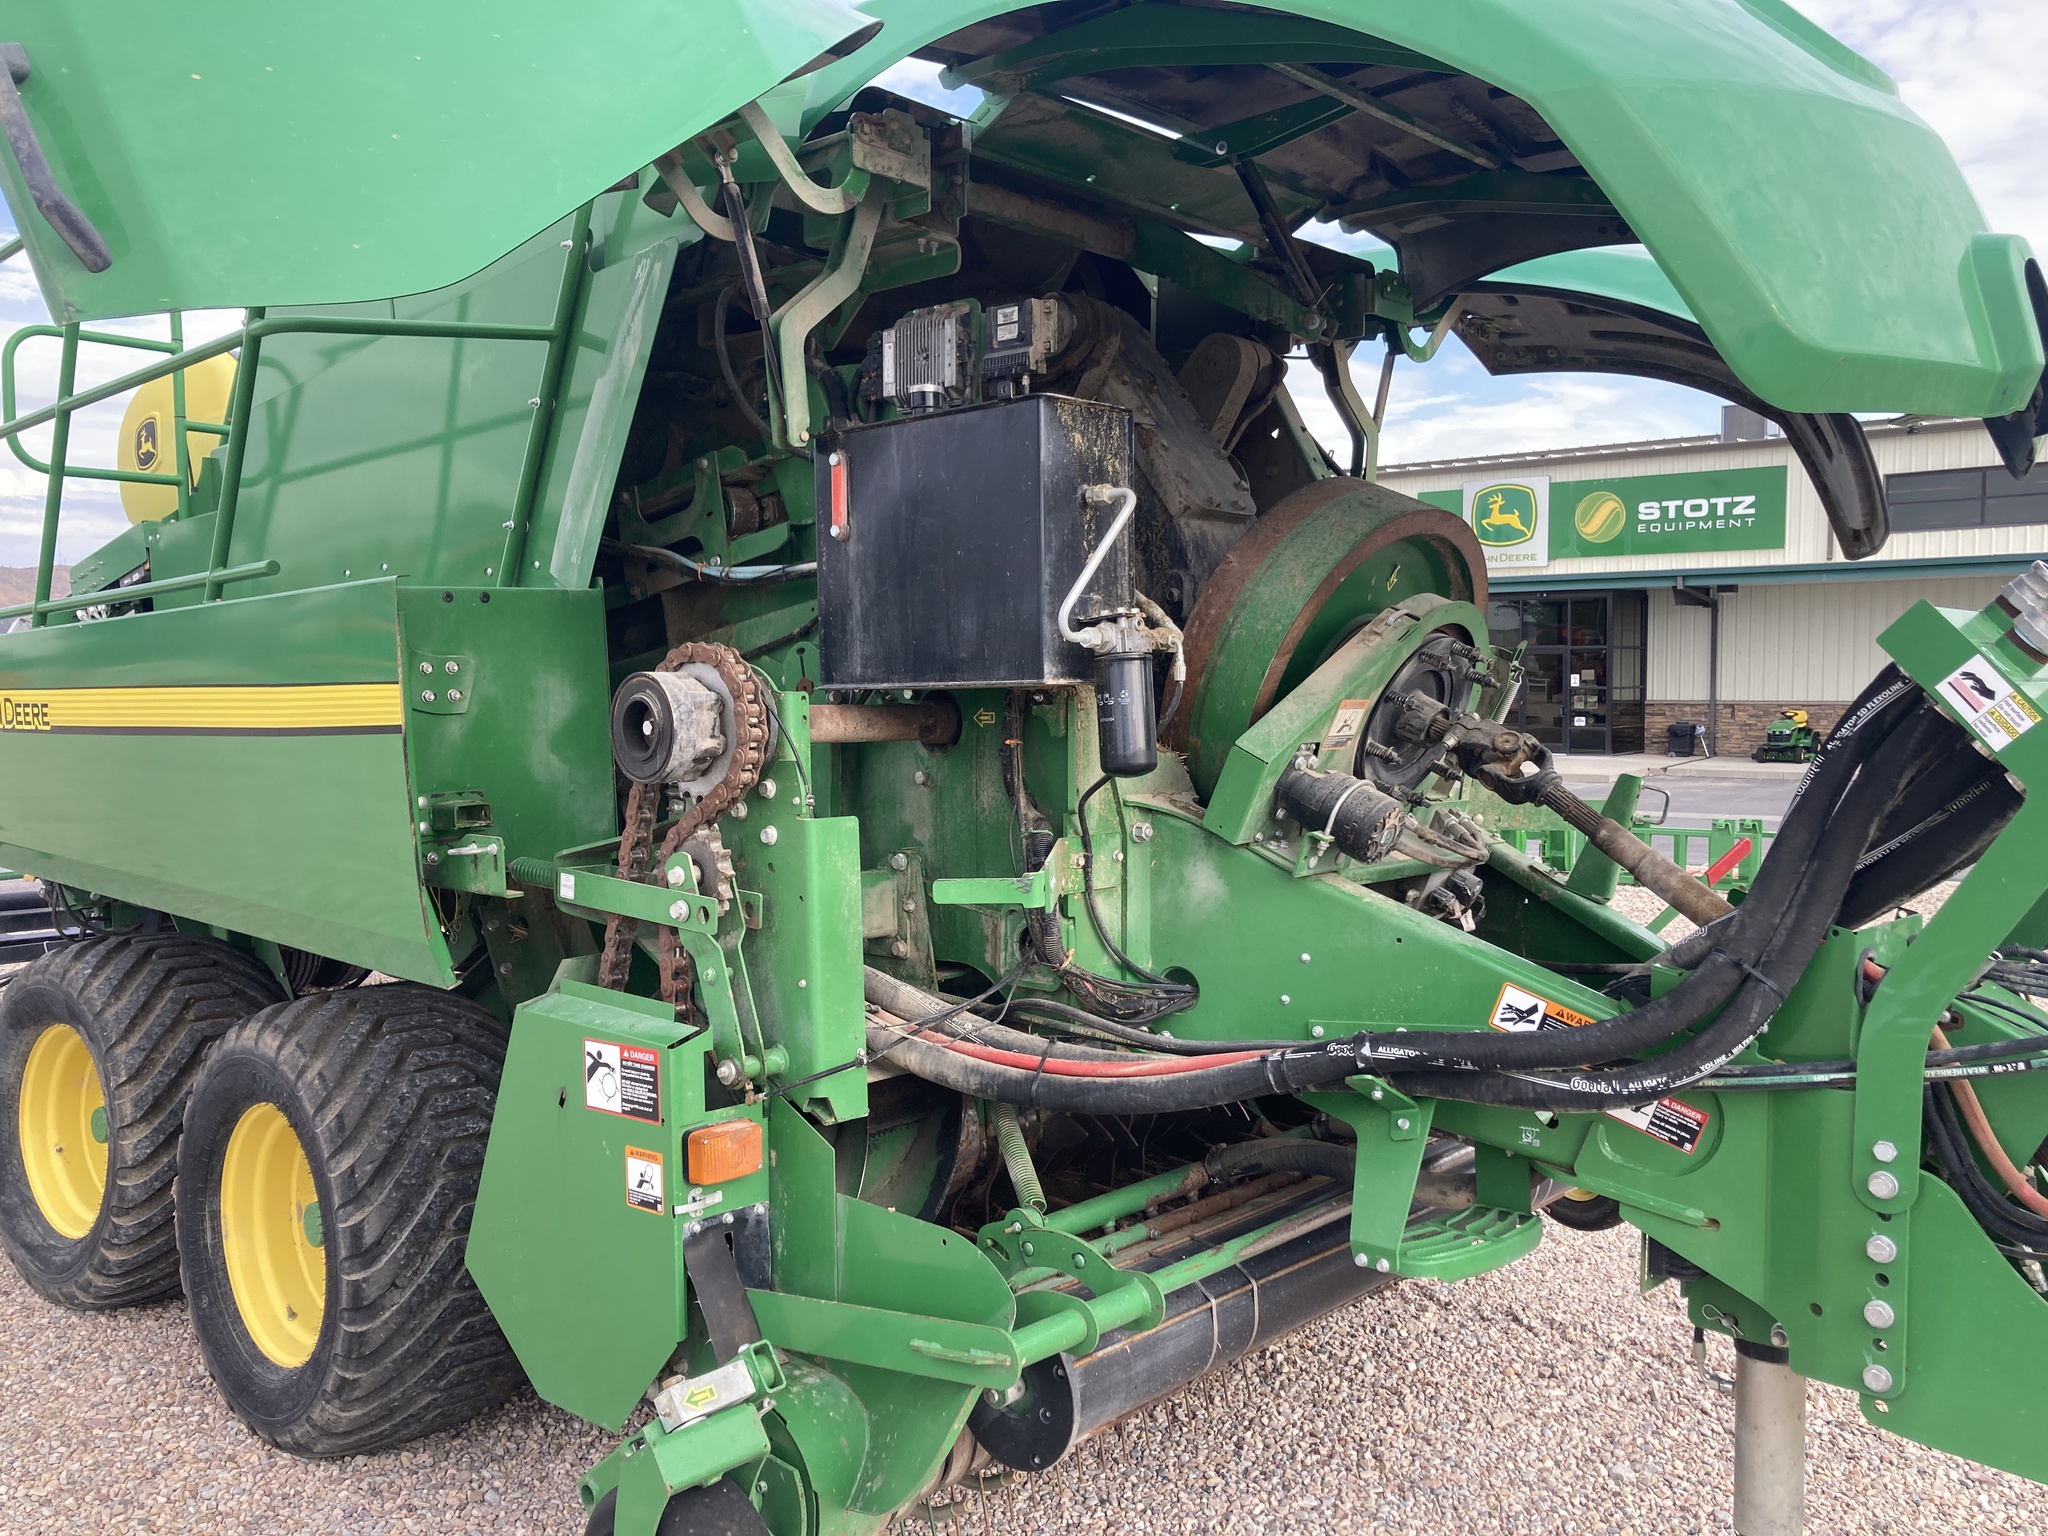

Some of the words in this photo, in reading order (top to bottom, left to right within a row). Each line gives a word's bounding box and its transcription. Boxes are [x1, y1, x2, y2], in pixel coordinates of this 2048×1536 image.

[1638, 495, 1756, 520] STOTZ
[1638, 518, 1755, 533] EQUIPMENT
[1500, 553, 1538, 562] DEERE
[1856, 706, 1868, 719] SD
[1866, 680, 1905, 710] FLEXOLINE
[2016, 697, 2039, 721] CAUTION
[4, 697, 50, 726] DEERE
[1994, 714, 2017, 737] CUIDADO
[1854, 846, 1890, 872] FLEXOLIN
[630, 1050, 654, 1062] DANGER
[1924, 1066, 1988, 1078] WEATHERHEAD
[1670, 1102, 1702, 1121] DANGER
